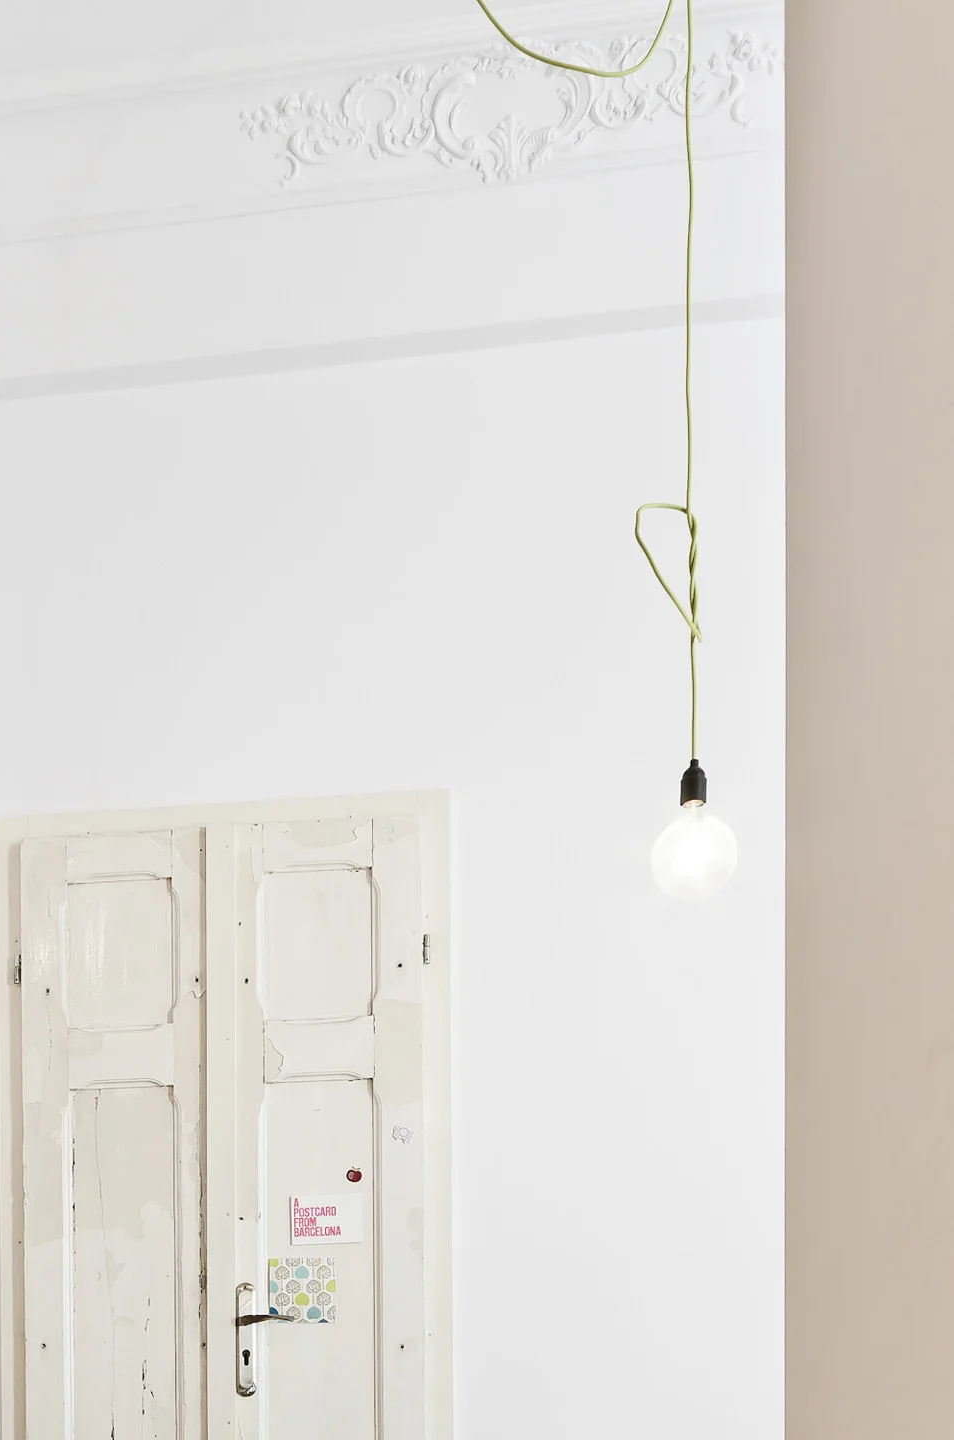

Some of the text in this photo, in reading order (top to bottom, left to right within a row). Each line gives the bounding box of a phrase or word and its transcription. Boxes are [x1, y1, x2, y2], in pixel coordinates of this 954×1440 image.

[293, 1197, 299, 1207] A
[293, 1206, 337, 1217] POSTCARD
[293, 1217, 317, 1227] FROM
[293, 1226, 341, 1237] BARCELONA
